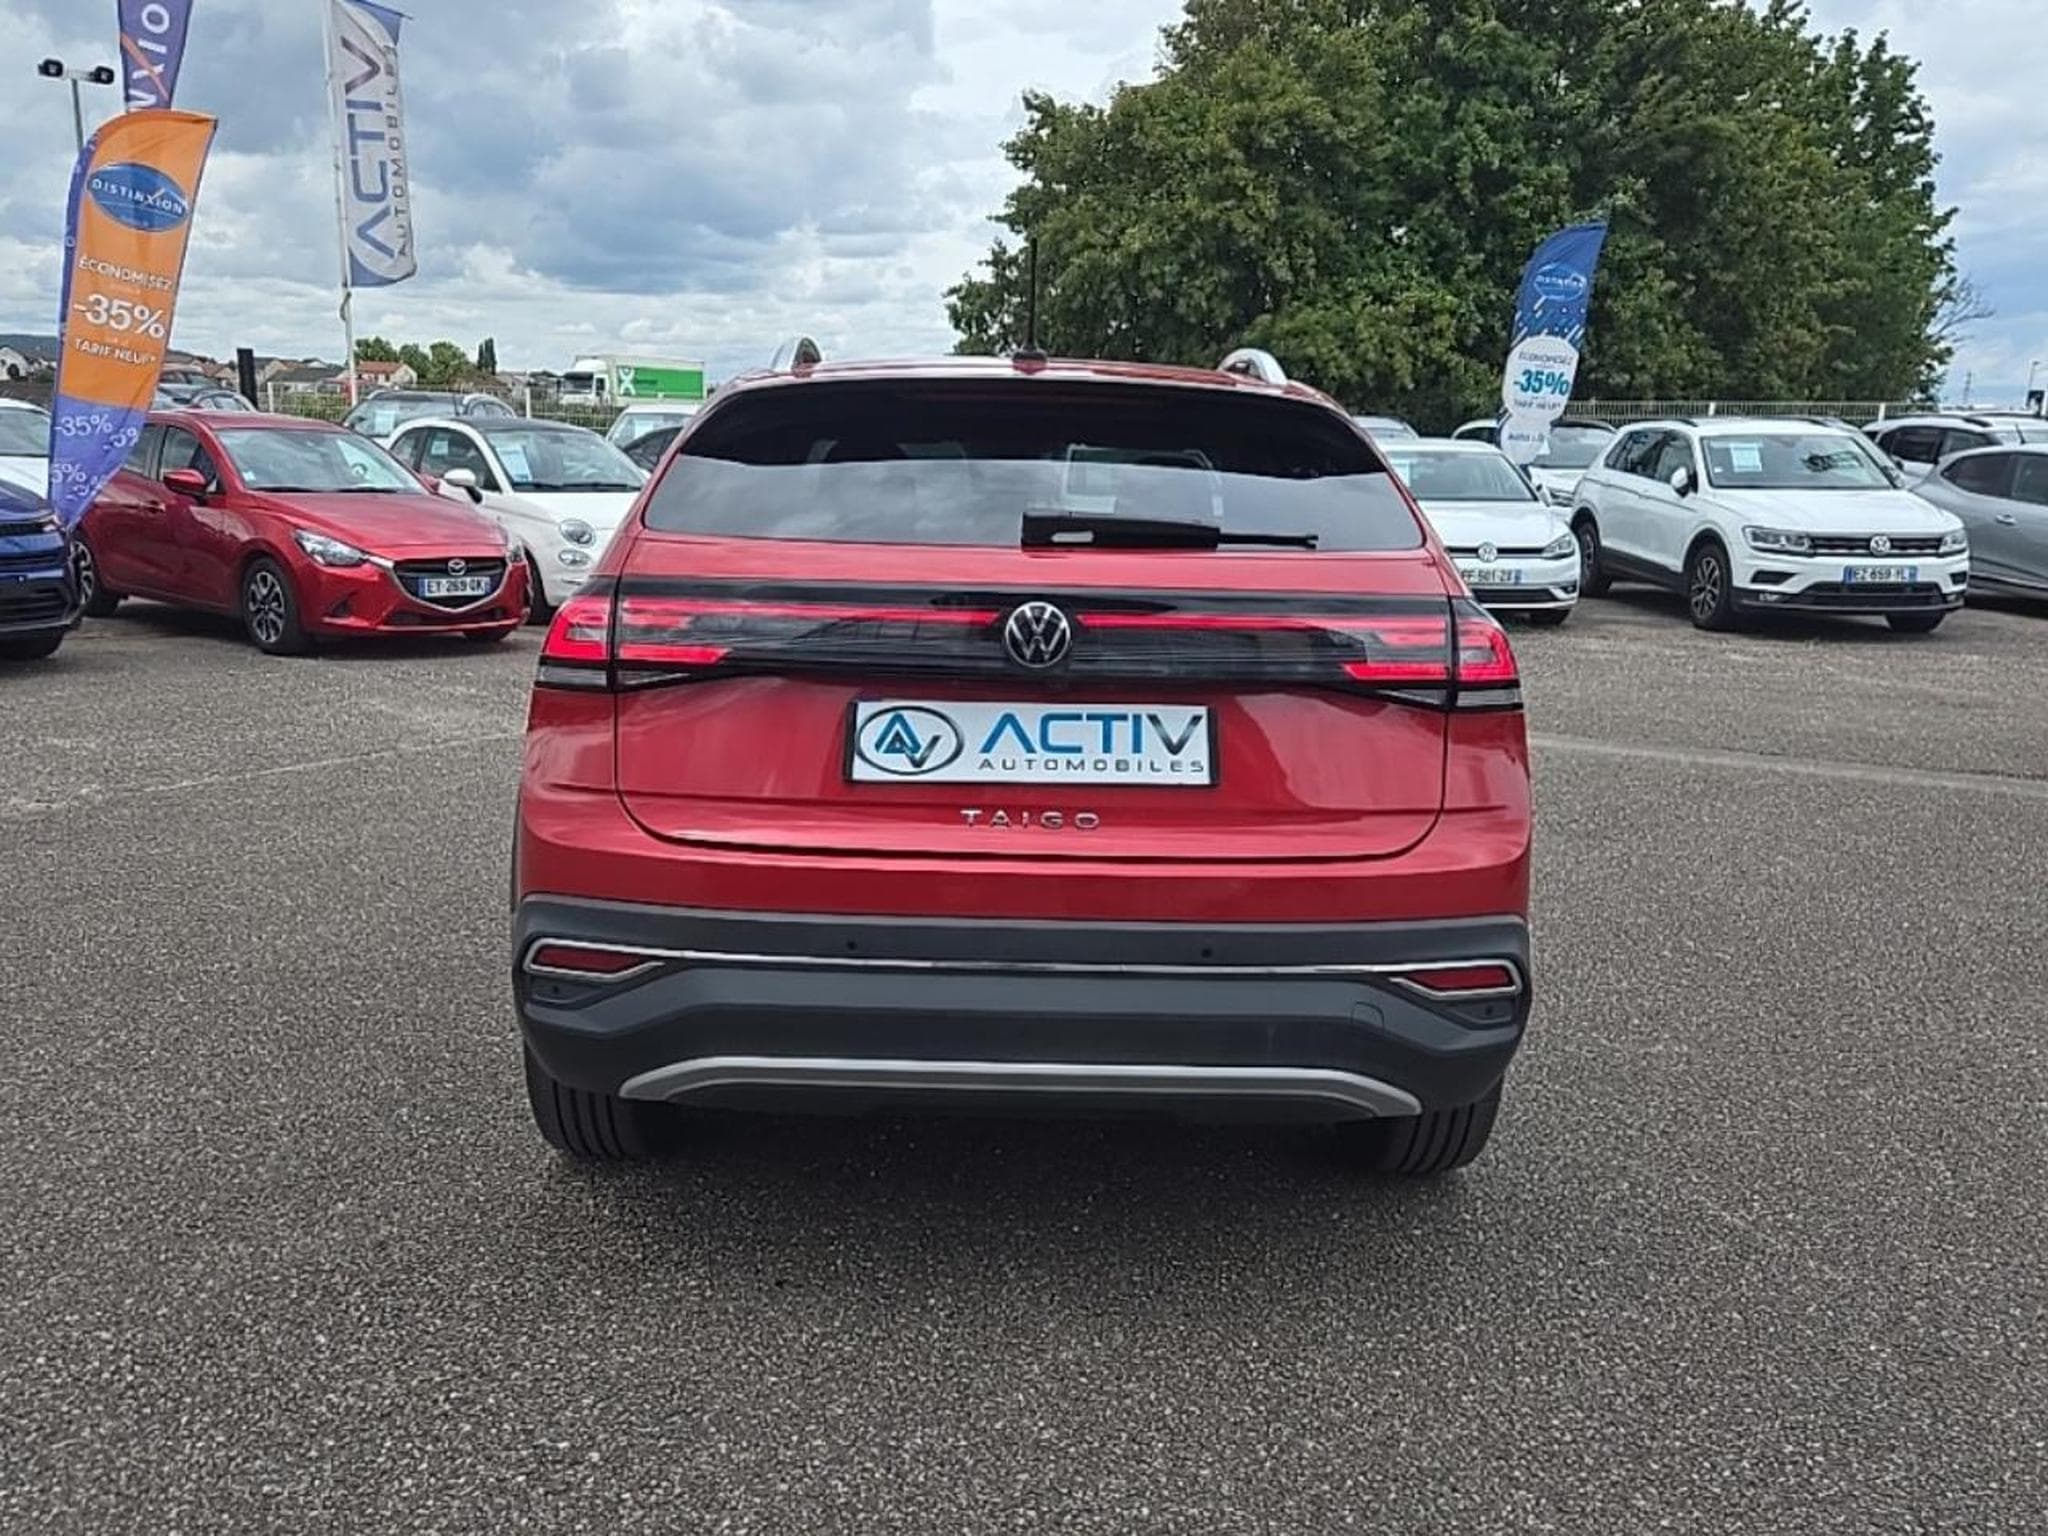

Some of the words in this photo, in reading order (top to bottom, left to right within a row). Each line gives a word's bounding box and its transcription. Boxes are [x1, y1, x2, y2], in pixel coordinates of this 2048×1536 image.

[341, 36, 395, 259] ACTIV
[91, 178, 184, 215] DISTINXION
[73, 293, 165, 338] -35%
[75, 339, 112, 355] TARIF
[1513, 369, 1570, 397] -35%
[54, 414, 113, 436] -35%
[980, 713, 1204, 756] ACTIV
[980, 758, 1204, 773] AUTOMOBILES
[960, 808, 1101, 829] TAIGO
